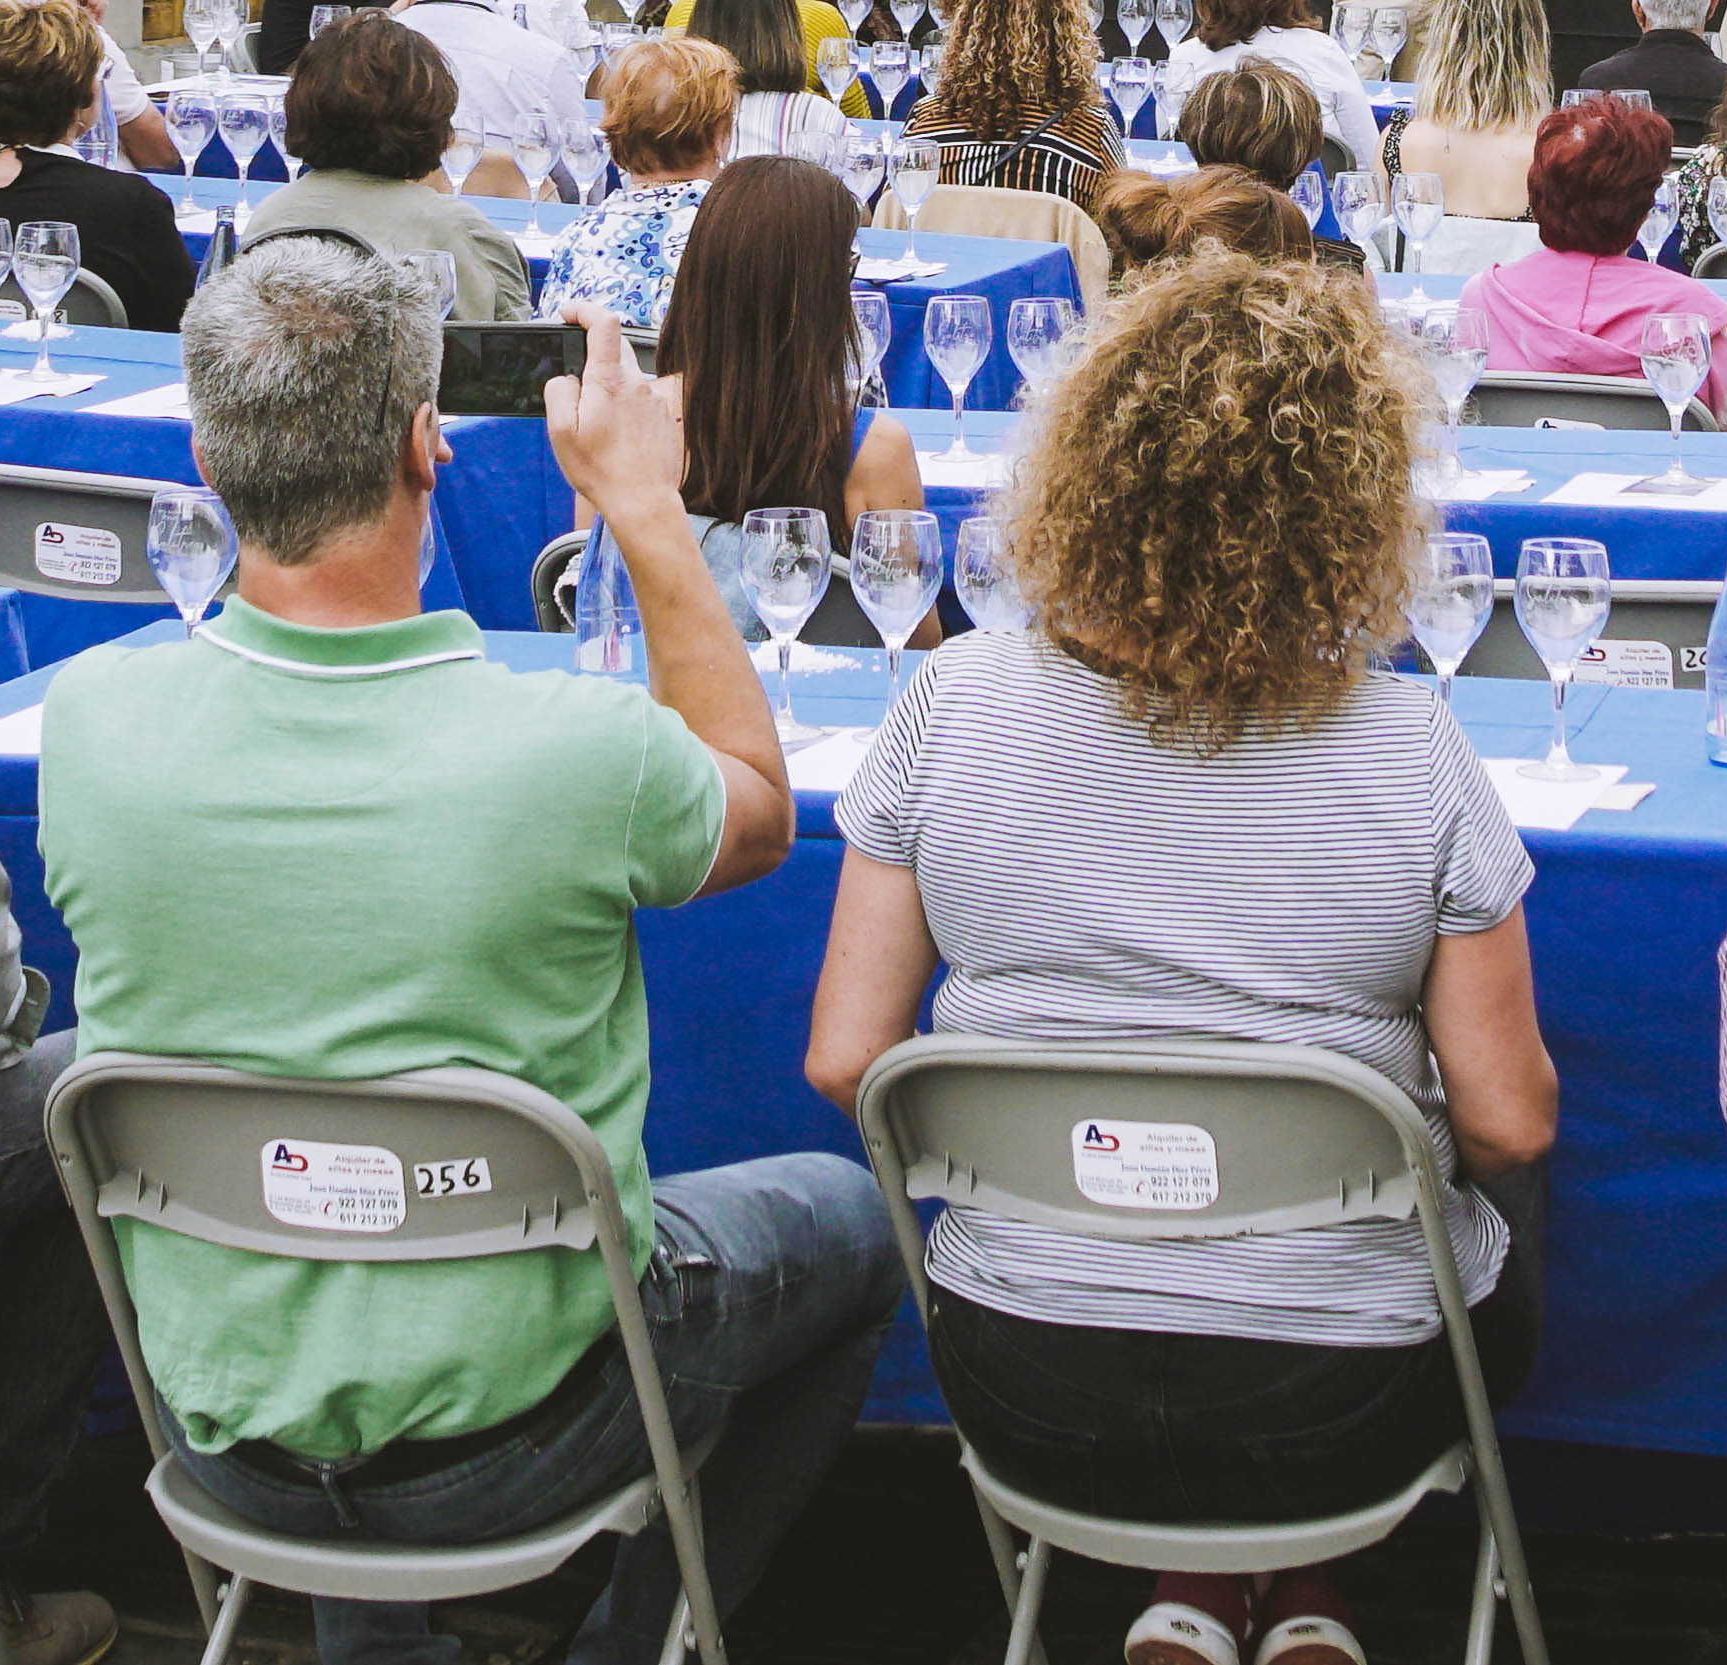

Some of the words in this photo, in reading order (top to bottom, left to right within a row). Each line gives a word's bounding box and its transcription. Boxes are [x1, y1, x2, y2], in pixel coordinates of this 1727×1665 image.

[419, 1159, 481, 1195] 256
[1150, 1176, 1169, 1187] 922
[1173, 1176, 1189, 1187] 127
[1192, 1177, 1211, 1188] 079
[338, 1197, 356, 1208] 922
[360, 1198, 377, 1209] 127
[380, 1199, 398, 1209] 079
[1151, 1192, 1170, 1202] 617
[1173, 1192, 1190, 1203] 212
[1194, 1192, 1213, 1204] 370
[339, 1213, 357, 1224] 617
[360, 1214, 378, 1225] 212
[382, 1214, 400, 1227] 370
